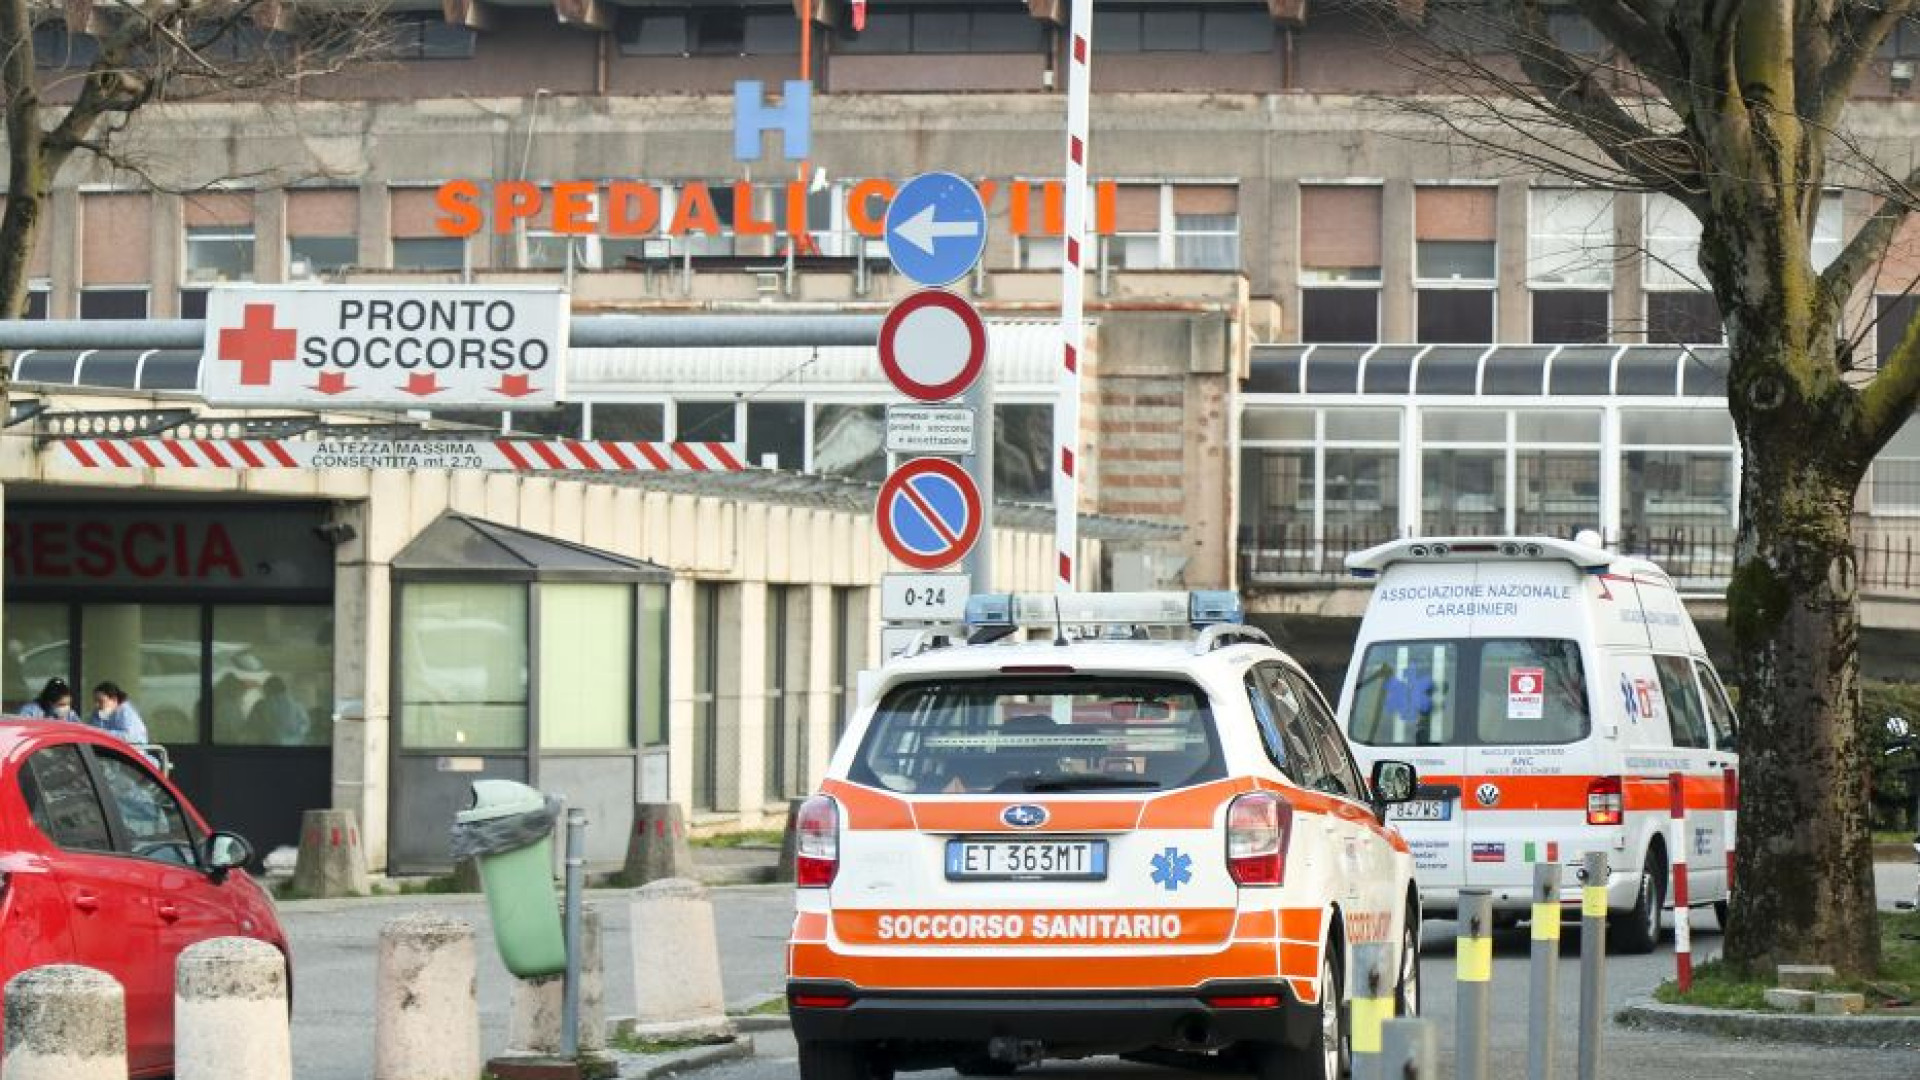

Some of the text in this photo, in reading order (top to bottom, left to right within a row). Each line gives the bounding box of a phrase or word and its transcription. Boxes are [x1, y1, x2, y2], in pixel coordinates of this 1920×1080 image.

[734, 79, 813, 161] H
[434, 178, 808, 237] SPEDALI
[338, 299, 515, 332] PRONTO
[301, 336, 549, 371] SOCCORSO
[318, 442, 476, 454] ALTEZZA MASSIMA
[311, 456, 418, 468] CONSENTITA
[451, 456, 482, 468] 2.70
[904, 587, 946, 606] 0-24
[1380, 584, 1572, 601] ASSOCIAZIONE NAZIONALE
[1425, 602, 1517, 617] CARABINIERI
[1511, 757, 1534, 766] ANC
[964, 845, 1087, 871] ET 363MT
[877, 914, 1182, 938] SOCCORSO SANITARIO
